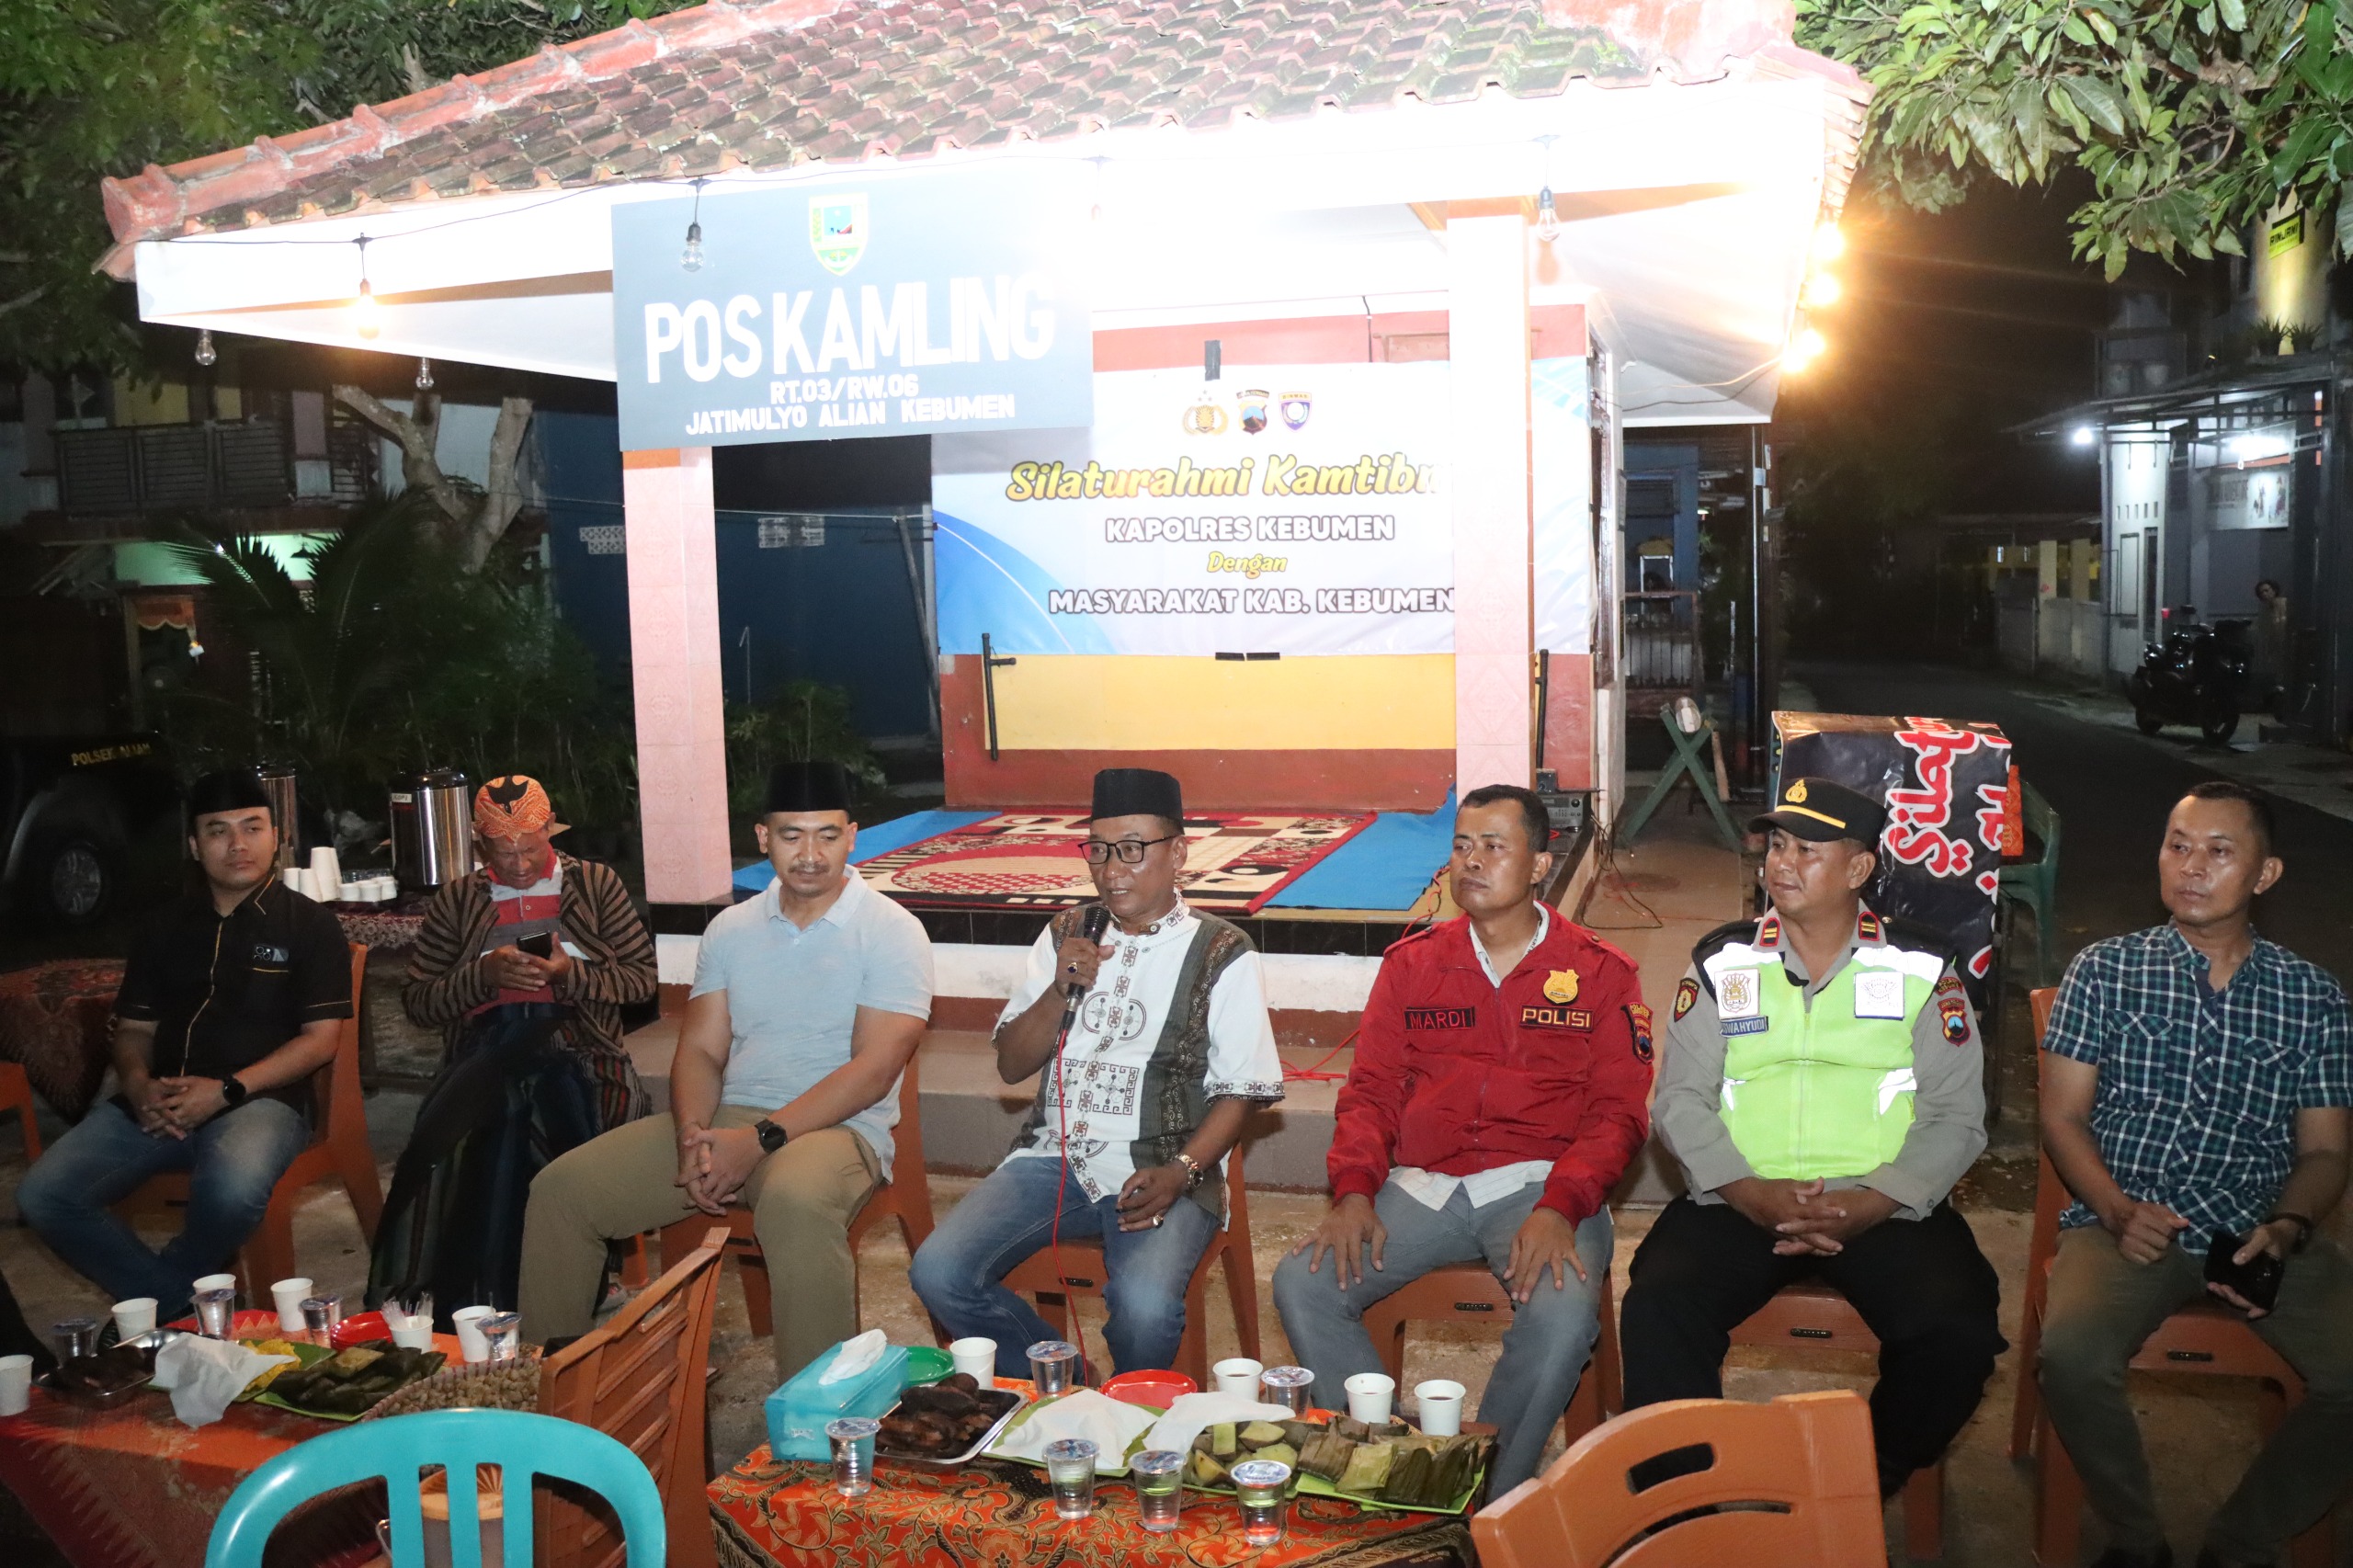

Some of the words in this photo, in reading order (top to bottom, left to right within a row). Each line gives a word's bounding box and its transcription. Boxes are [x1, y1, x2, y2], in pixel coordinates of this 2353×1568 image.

[644, 294, 762, 383] POS
[772, 273, 1056, 375] KAMLING
[770, 373, 919, 404] RT.03/RW.06
[685, 405, 808, 436] JATIMULYO
[818, 401, 886, 428] ALIAN
[901, 393, 1015, 424] KEBUMEN
[1006, 456, 1256, 502] Silaturahmi
[1106, 517, 1252, 542] KAPOLRES
[1256, 515, 1395, 541] KEBUMEN
[1206, 551, 1288, 579] Dengan
[1048, 588, 1238, 614] MASYARAKAT
[1244, 587, 1311, 614] KAB.
[1315, 586, 1455, 614] KEBUMEN
[1409, 1011, 1467, 1030] MARDI
[1521, 1007, 1591, 1028] POLISI
